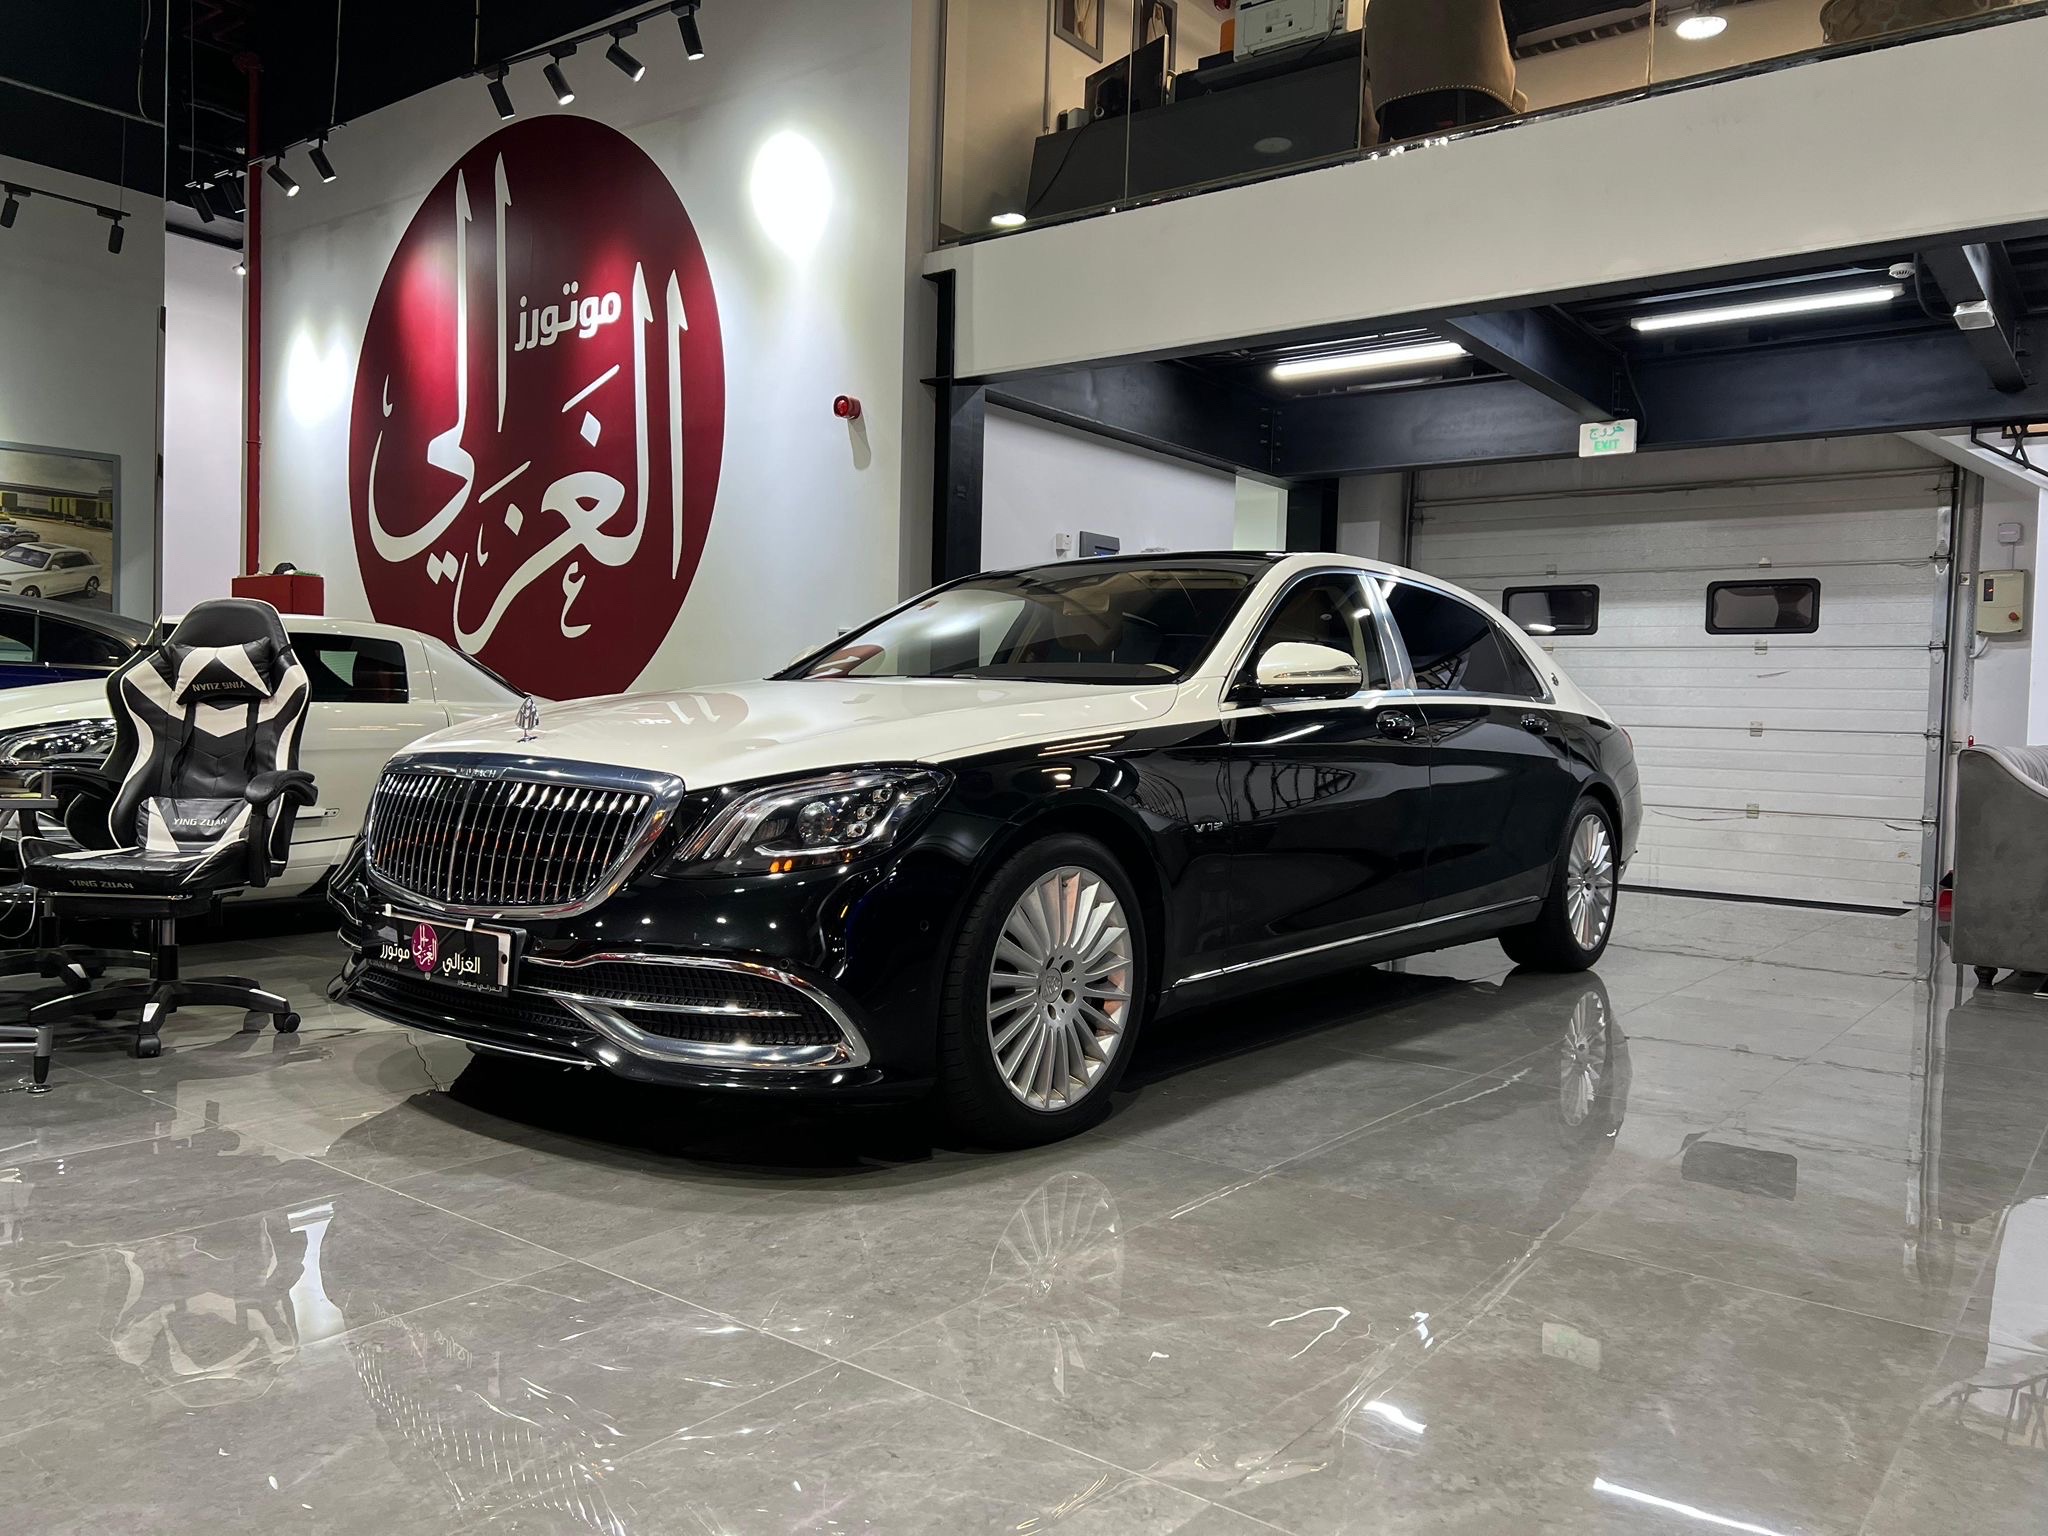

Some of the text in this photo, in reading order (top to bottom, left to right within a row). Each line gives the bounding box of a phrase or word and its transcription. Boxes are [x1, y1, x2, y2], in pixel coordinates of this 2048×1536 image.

[515, 281, 622, 351] موتورز
[1590, 422, 1624, 440] خروج
[1594, 440, 1619, 452] EXIT
[192, 681, 246, 692] YING ZUAN
[173, 817, 228, 827] YING ZUAN
[1193, 821, 1223, 833] V12
[99, 881, 134, 889] ZUAN
[442, 952, 480, 977] الغزالي
